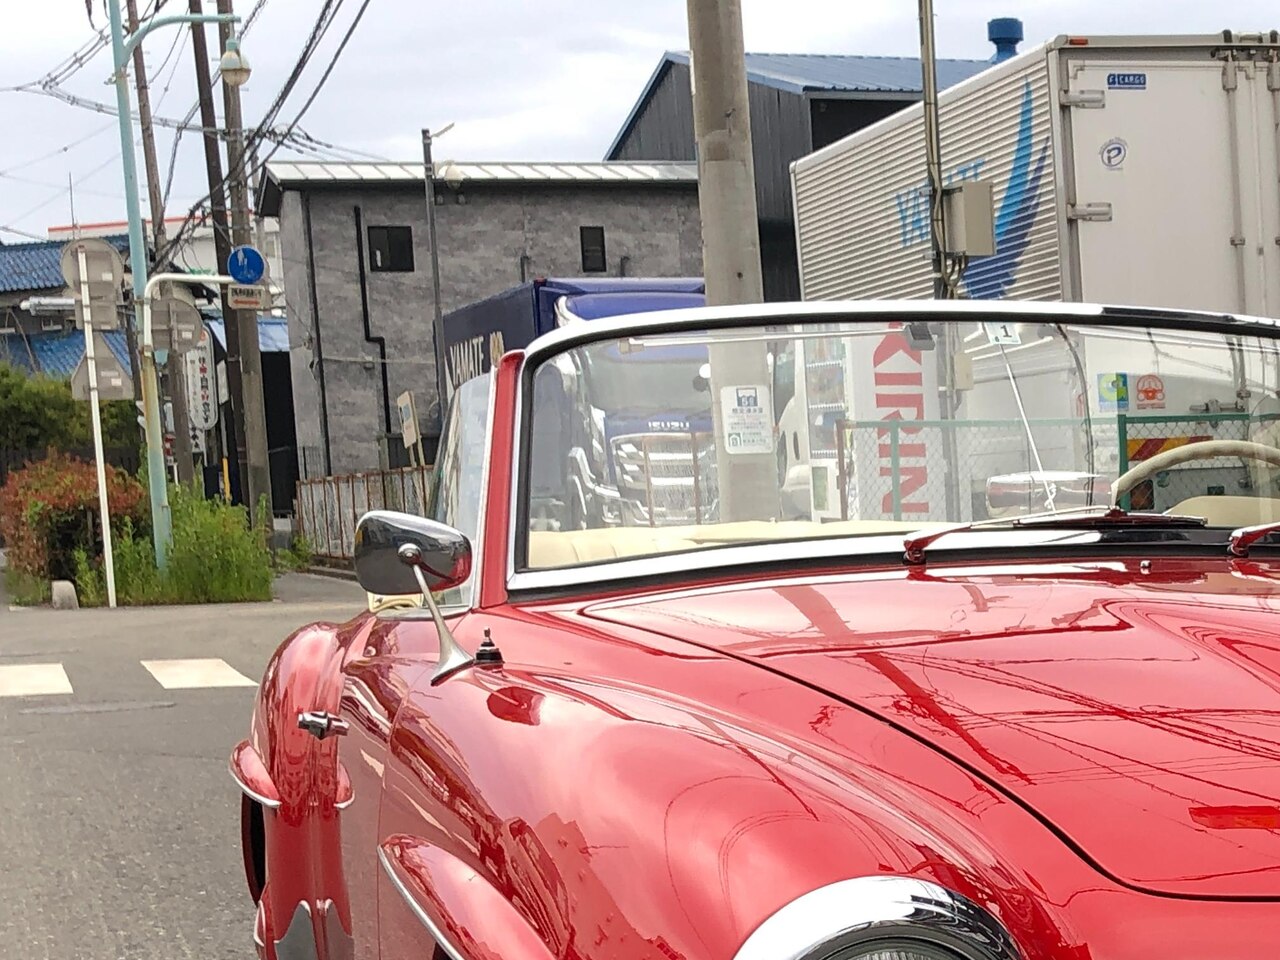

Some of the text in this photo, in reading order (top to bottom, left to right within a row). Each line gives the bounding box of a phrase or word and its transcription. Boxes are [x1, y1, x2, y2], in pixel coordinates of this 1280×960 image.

[449, 335, 485, 389] YAMATE
[648, 421, 690, 431] ISUZU
[873, 321, 930, 513] KIRIN
